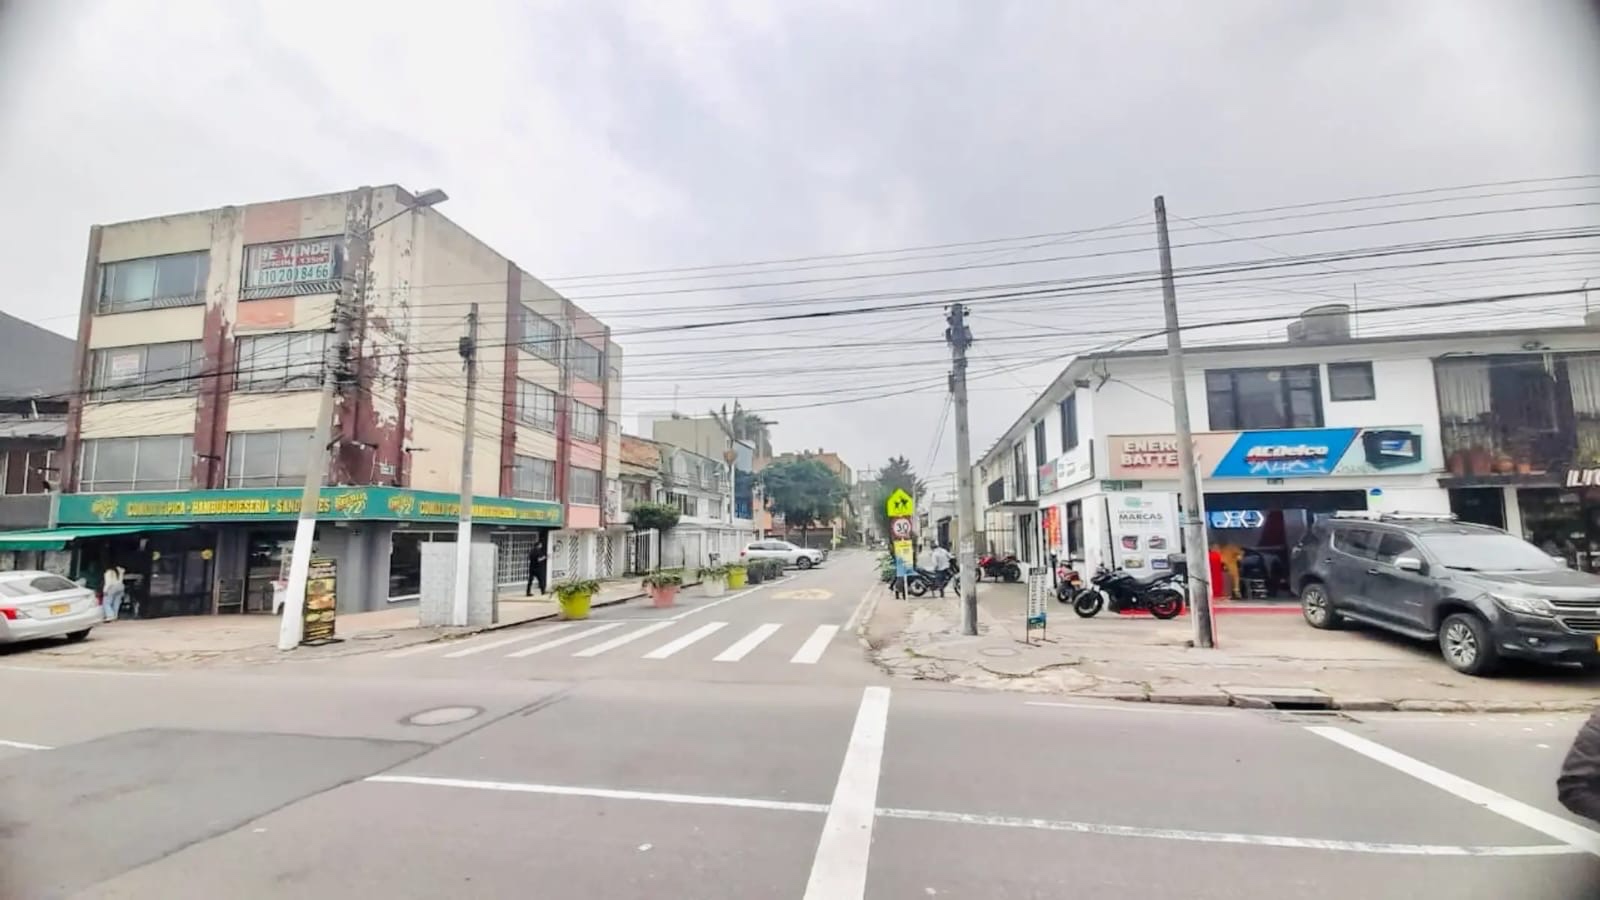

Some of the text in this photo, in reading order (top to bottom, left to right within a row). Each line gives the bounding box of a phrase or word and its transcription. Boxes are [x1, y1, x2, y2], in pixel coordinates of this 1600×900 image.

[1246, 443, 1329, 458] ACDelco
[1120, 452, 1179, 467] BATTE
[1118, 512, 1163, 521] MARCAS
[895, 522, 909, 533] 30
